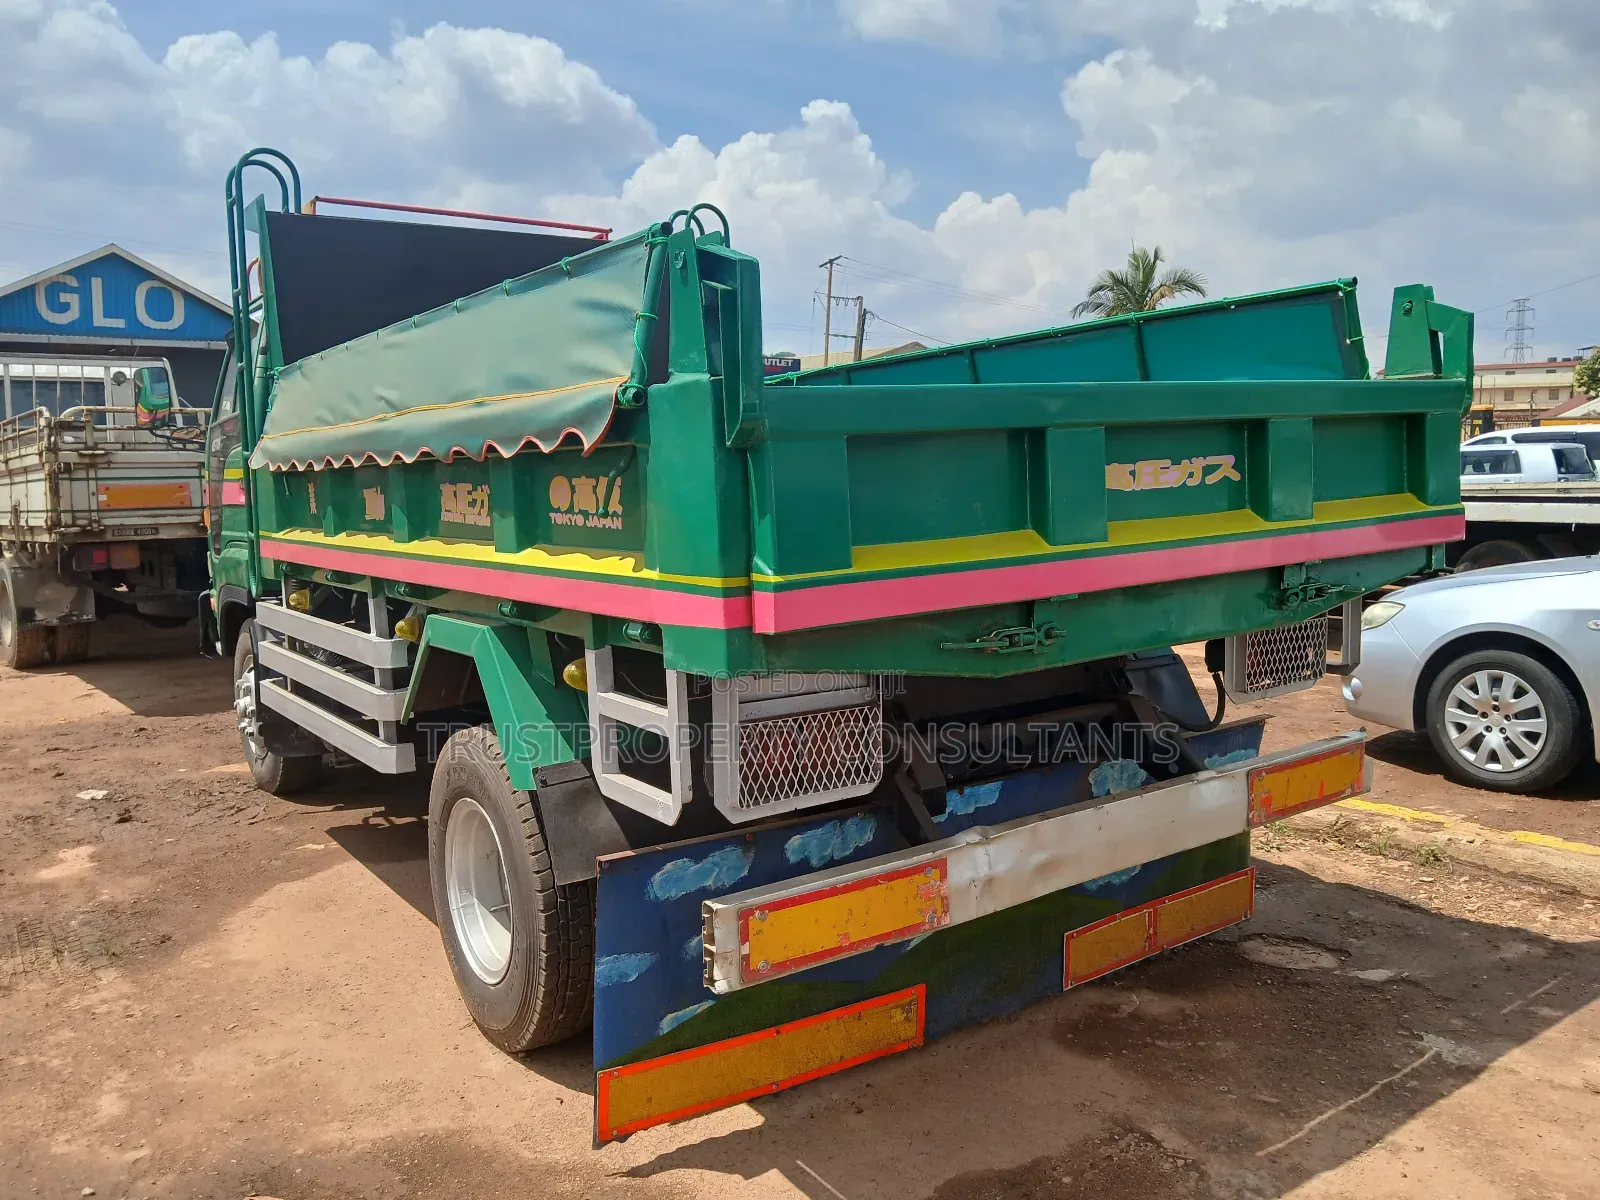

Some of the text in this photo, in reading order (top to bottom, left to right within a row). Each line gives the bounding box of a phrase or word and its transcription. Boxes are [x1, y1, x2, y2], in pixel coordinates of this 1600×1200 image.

[36, 275, 185, 330] GLO
[549, 512, 622, 529] TOKYO JAPAN
